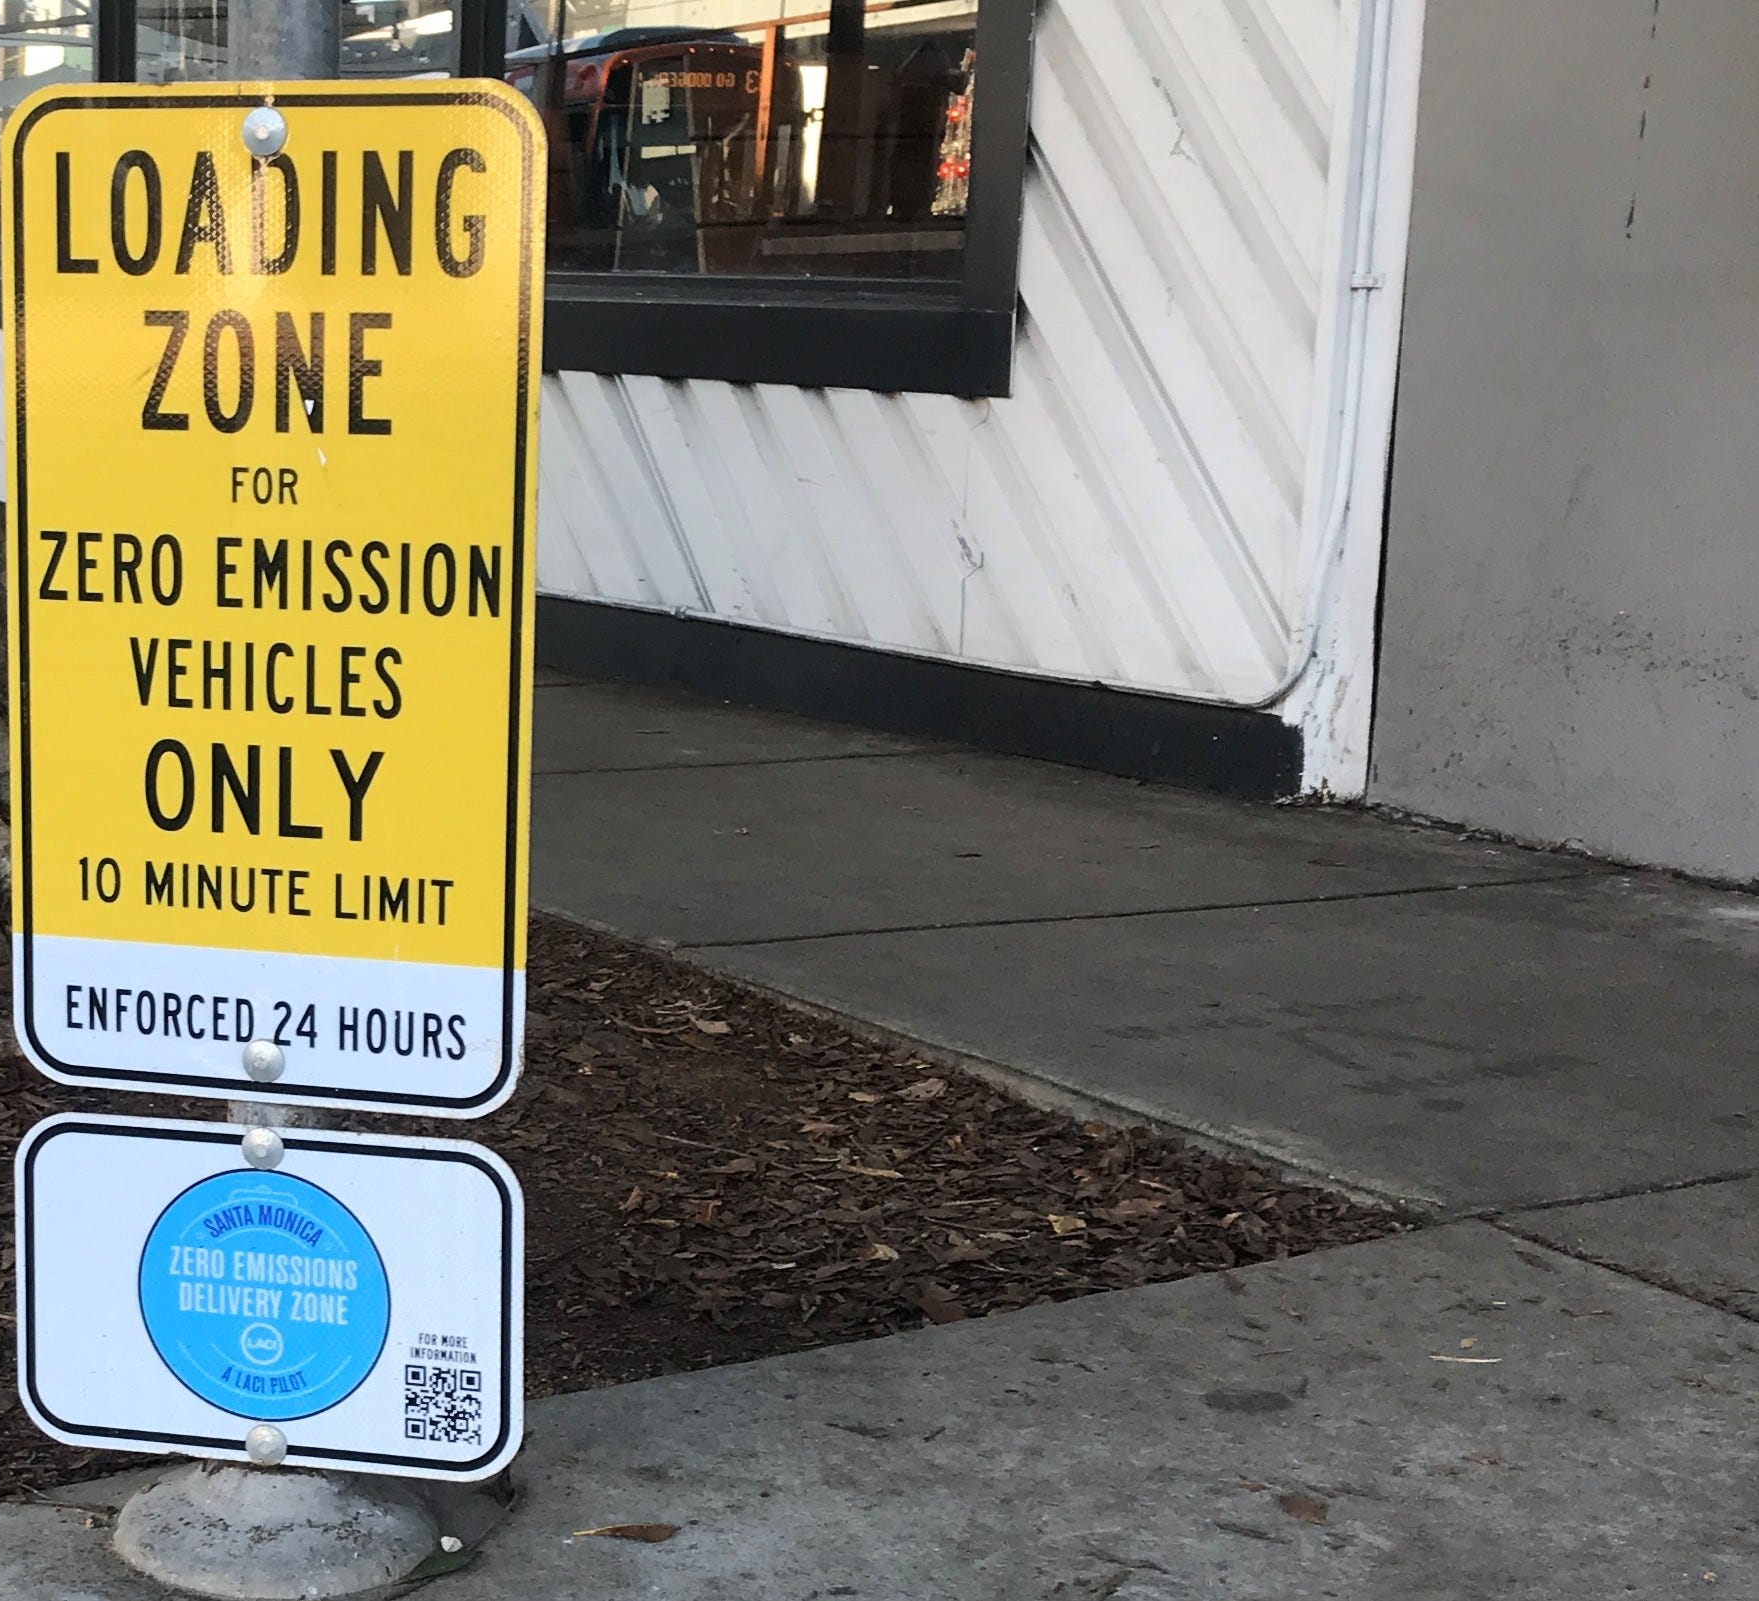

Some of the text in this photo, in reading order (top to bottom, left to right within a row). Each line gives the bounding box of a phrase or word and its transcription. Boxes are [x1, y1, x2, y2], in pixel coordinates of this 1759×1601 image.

[56, 148, 487, 278] LOADING
[141, 309, 393, 435] ZONE
[231, 466, 299, 505] FOR
[39, 530, 502, 618] ZERO EMISSION
[129, 637, 403, 719] VEHICLES
[144, 738, 385, 842] ONLY
[78, 857, 455, 926] 10 MINUTE LIMIT
[66, 985, 467, 1060] ENFORCED 24 HOURS
[203, 1204, 324, 1247] SANTA MONICA
[169, 1245, 358, 1290] ZERO EMISSIONS
[179, 1282, 349, 1326] DELIVERY ZONE
[246, 1338, 278, 1350] LACI
[409, 1346, 477, 1364] INFORMATION
[418, 1332, 469, 1349] FOR MORE
[221, 1366, 308, 1395] A LACI PILOT
